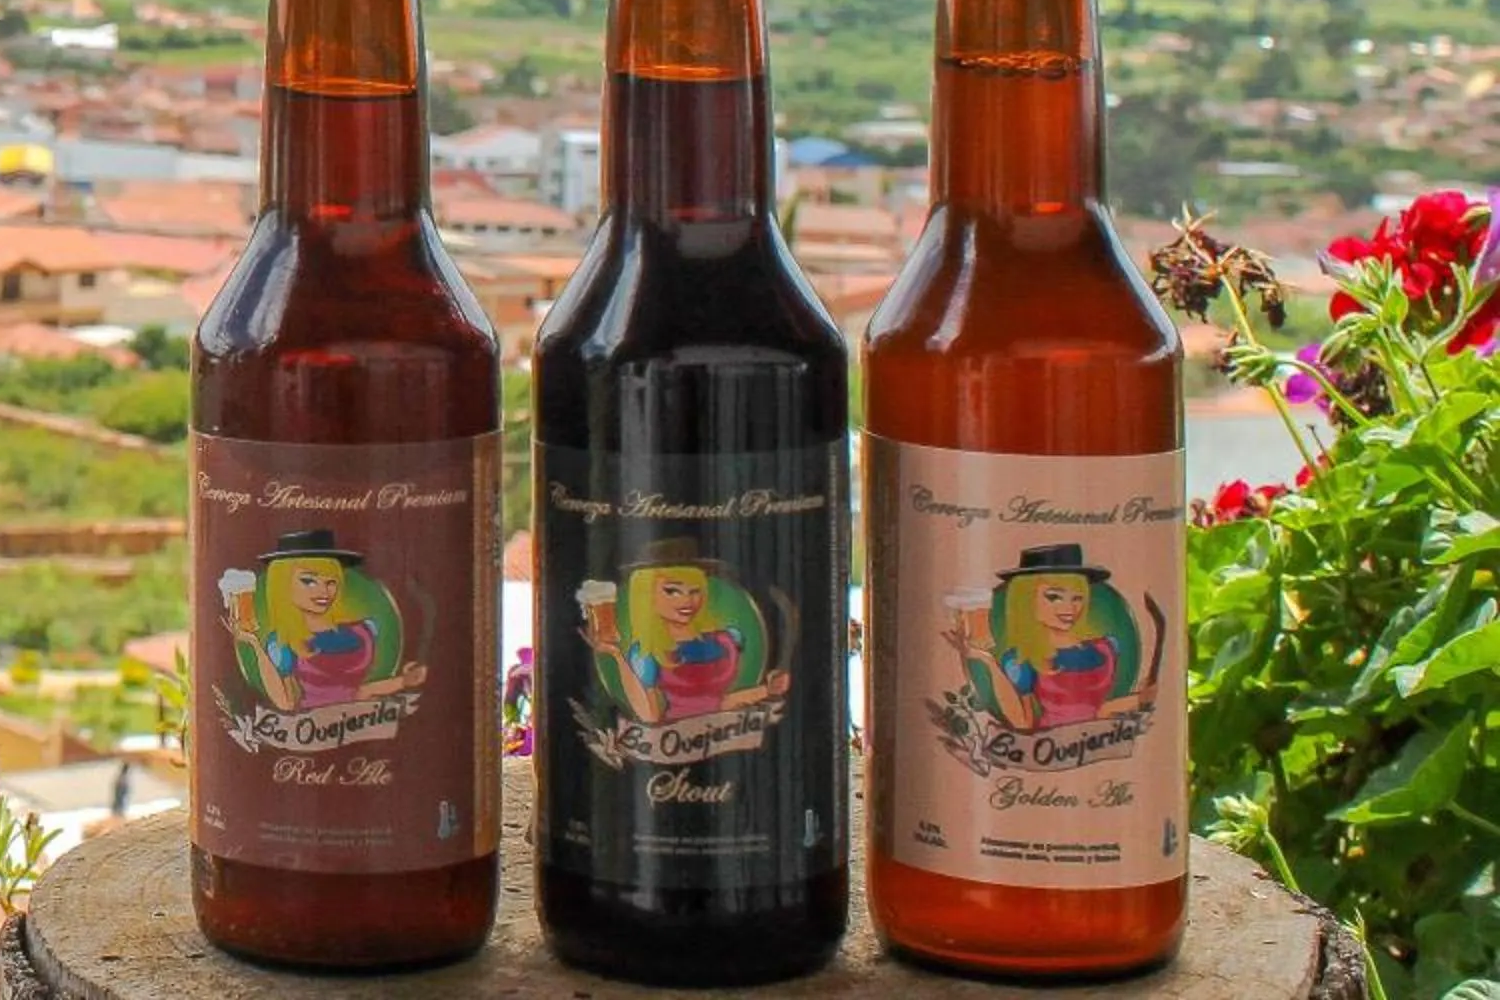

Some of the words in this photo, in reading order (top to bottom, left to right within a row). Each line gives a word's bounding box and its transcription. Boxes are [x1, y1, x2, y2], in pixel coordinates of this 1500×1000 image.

[257, 481, 373, 510] Artesanal
[376, 482, 468, 510] Premium
[617, 489, 736, 518] Artesanal
[909, 484, 990, 528] Cerveza
[998, 495, 1120, 524] Artesanal
[272, 755, 336, 786] Red
[338, 756, 393, 786] Ale
[646, 765, 734, 808] Stout
[989, 775, 1080, 811] Golden
[1087, 779, 1137, 809] Ale
